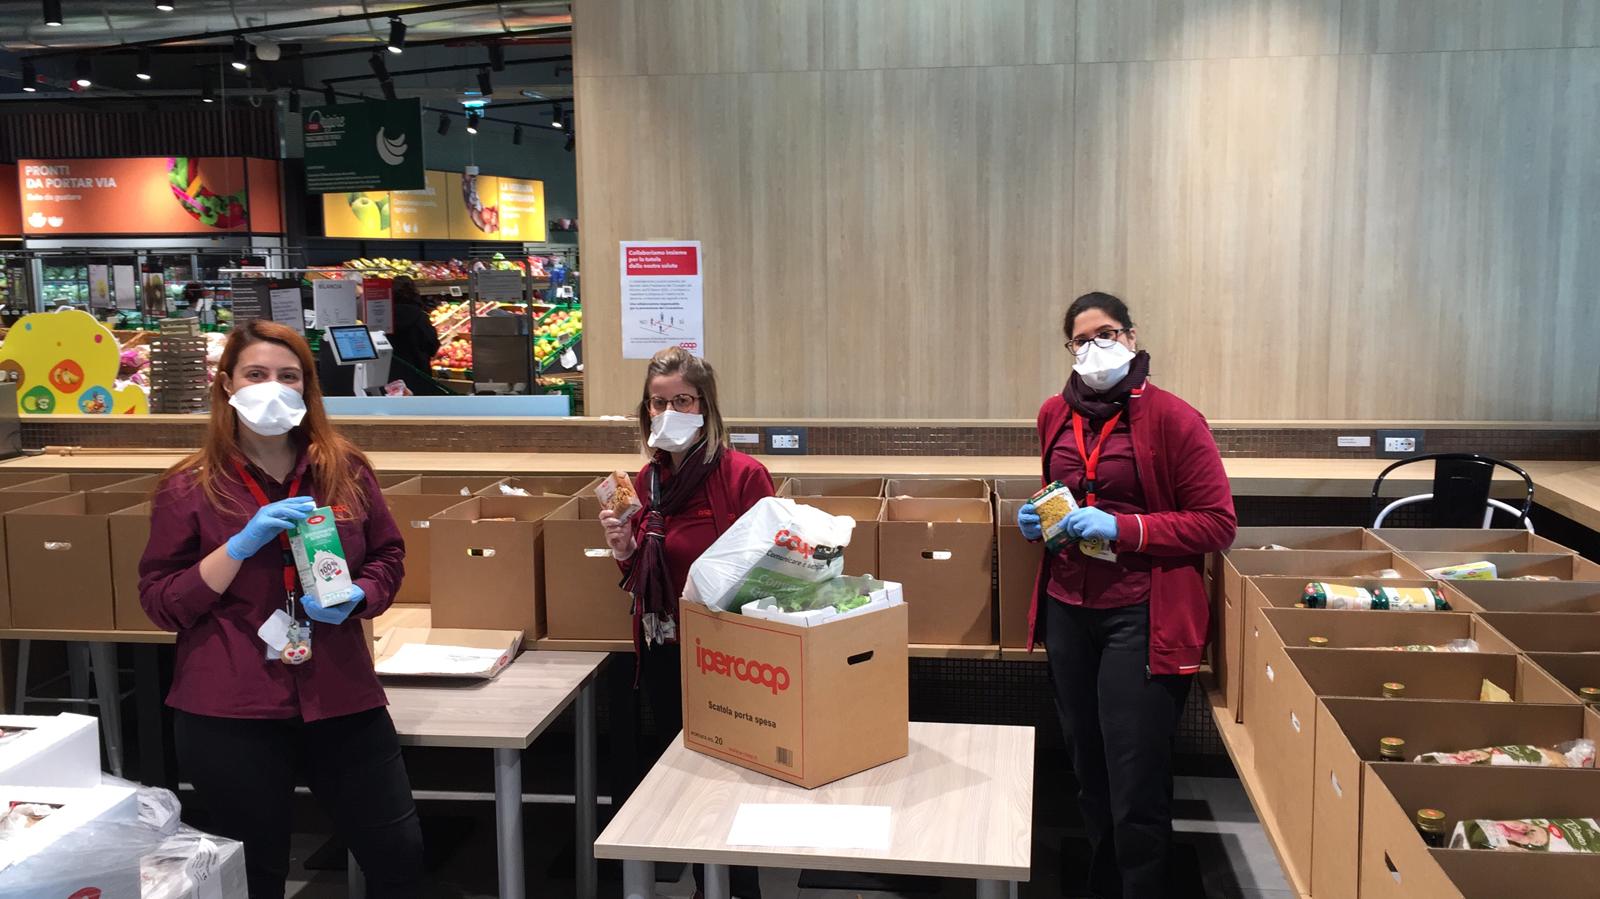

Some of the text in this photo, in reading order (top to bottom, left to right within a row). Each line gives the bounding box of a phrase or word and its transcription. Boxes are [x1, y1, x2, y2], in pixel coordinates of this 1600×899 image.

[25, 166, 70, 176] PRONTI
[26, 177, 117, 188] DA PORTAR VIA
[695, 638, 790, 695] ipercoop
[708, 700, 777, 729] Scatola porta spesa
[714, 735, 724, 746] 20
